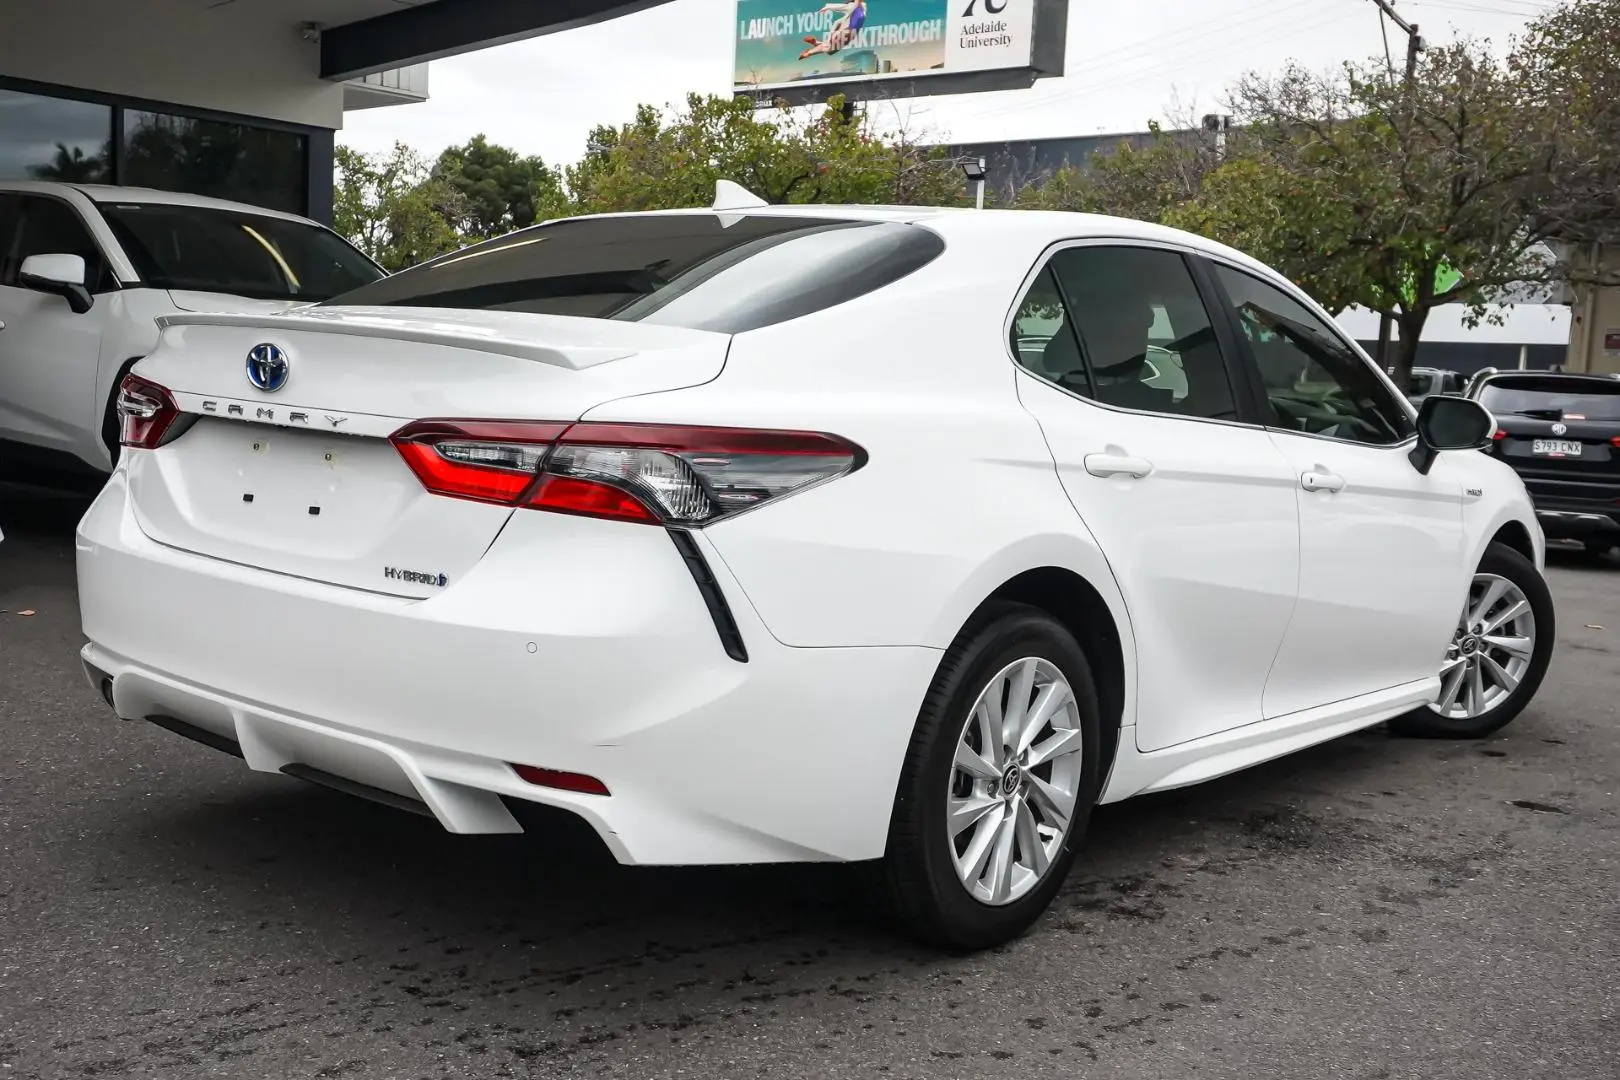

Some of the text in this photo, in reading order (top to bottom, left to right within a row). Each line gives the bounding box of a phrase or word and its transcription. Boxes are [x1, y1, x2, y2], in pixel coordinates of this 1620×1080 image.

[740, 10, 834, 40] LAUNCH YOUR
[961, 20, 1007, 35] Adelaide
[960, 34, 1011, 49] University
[202, 400, 348, 427] CAMRY
[384, 566, 437, 585] HYBRID
